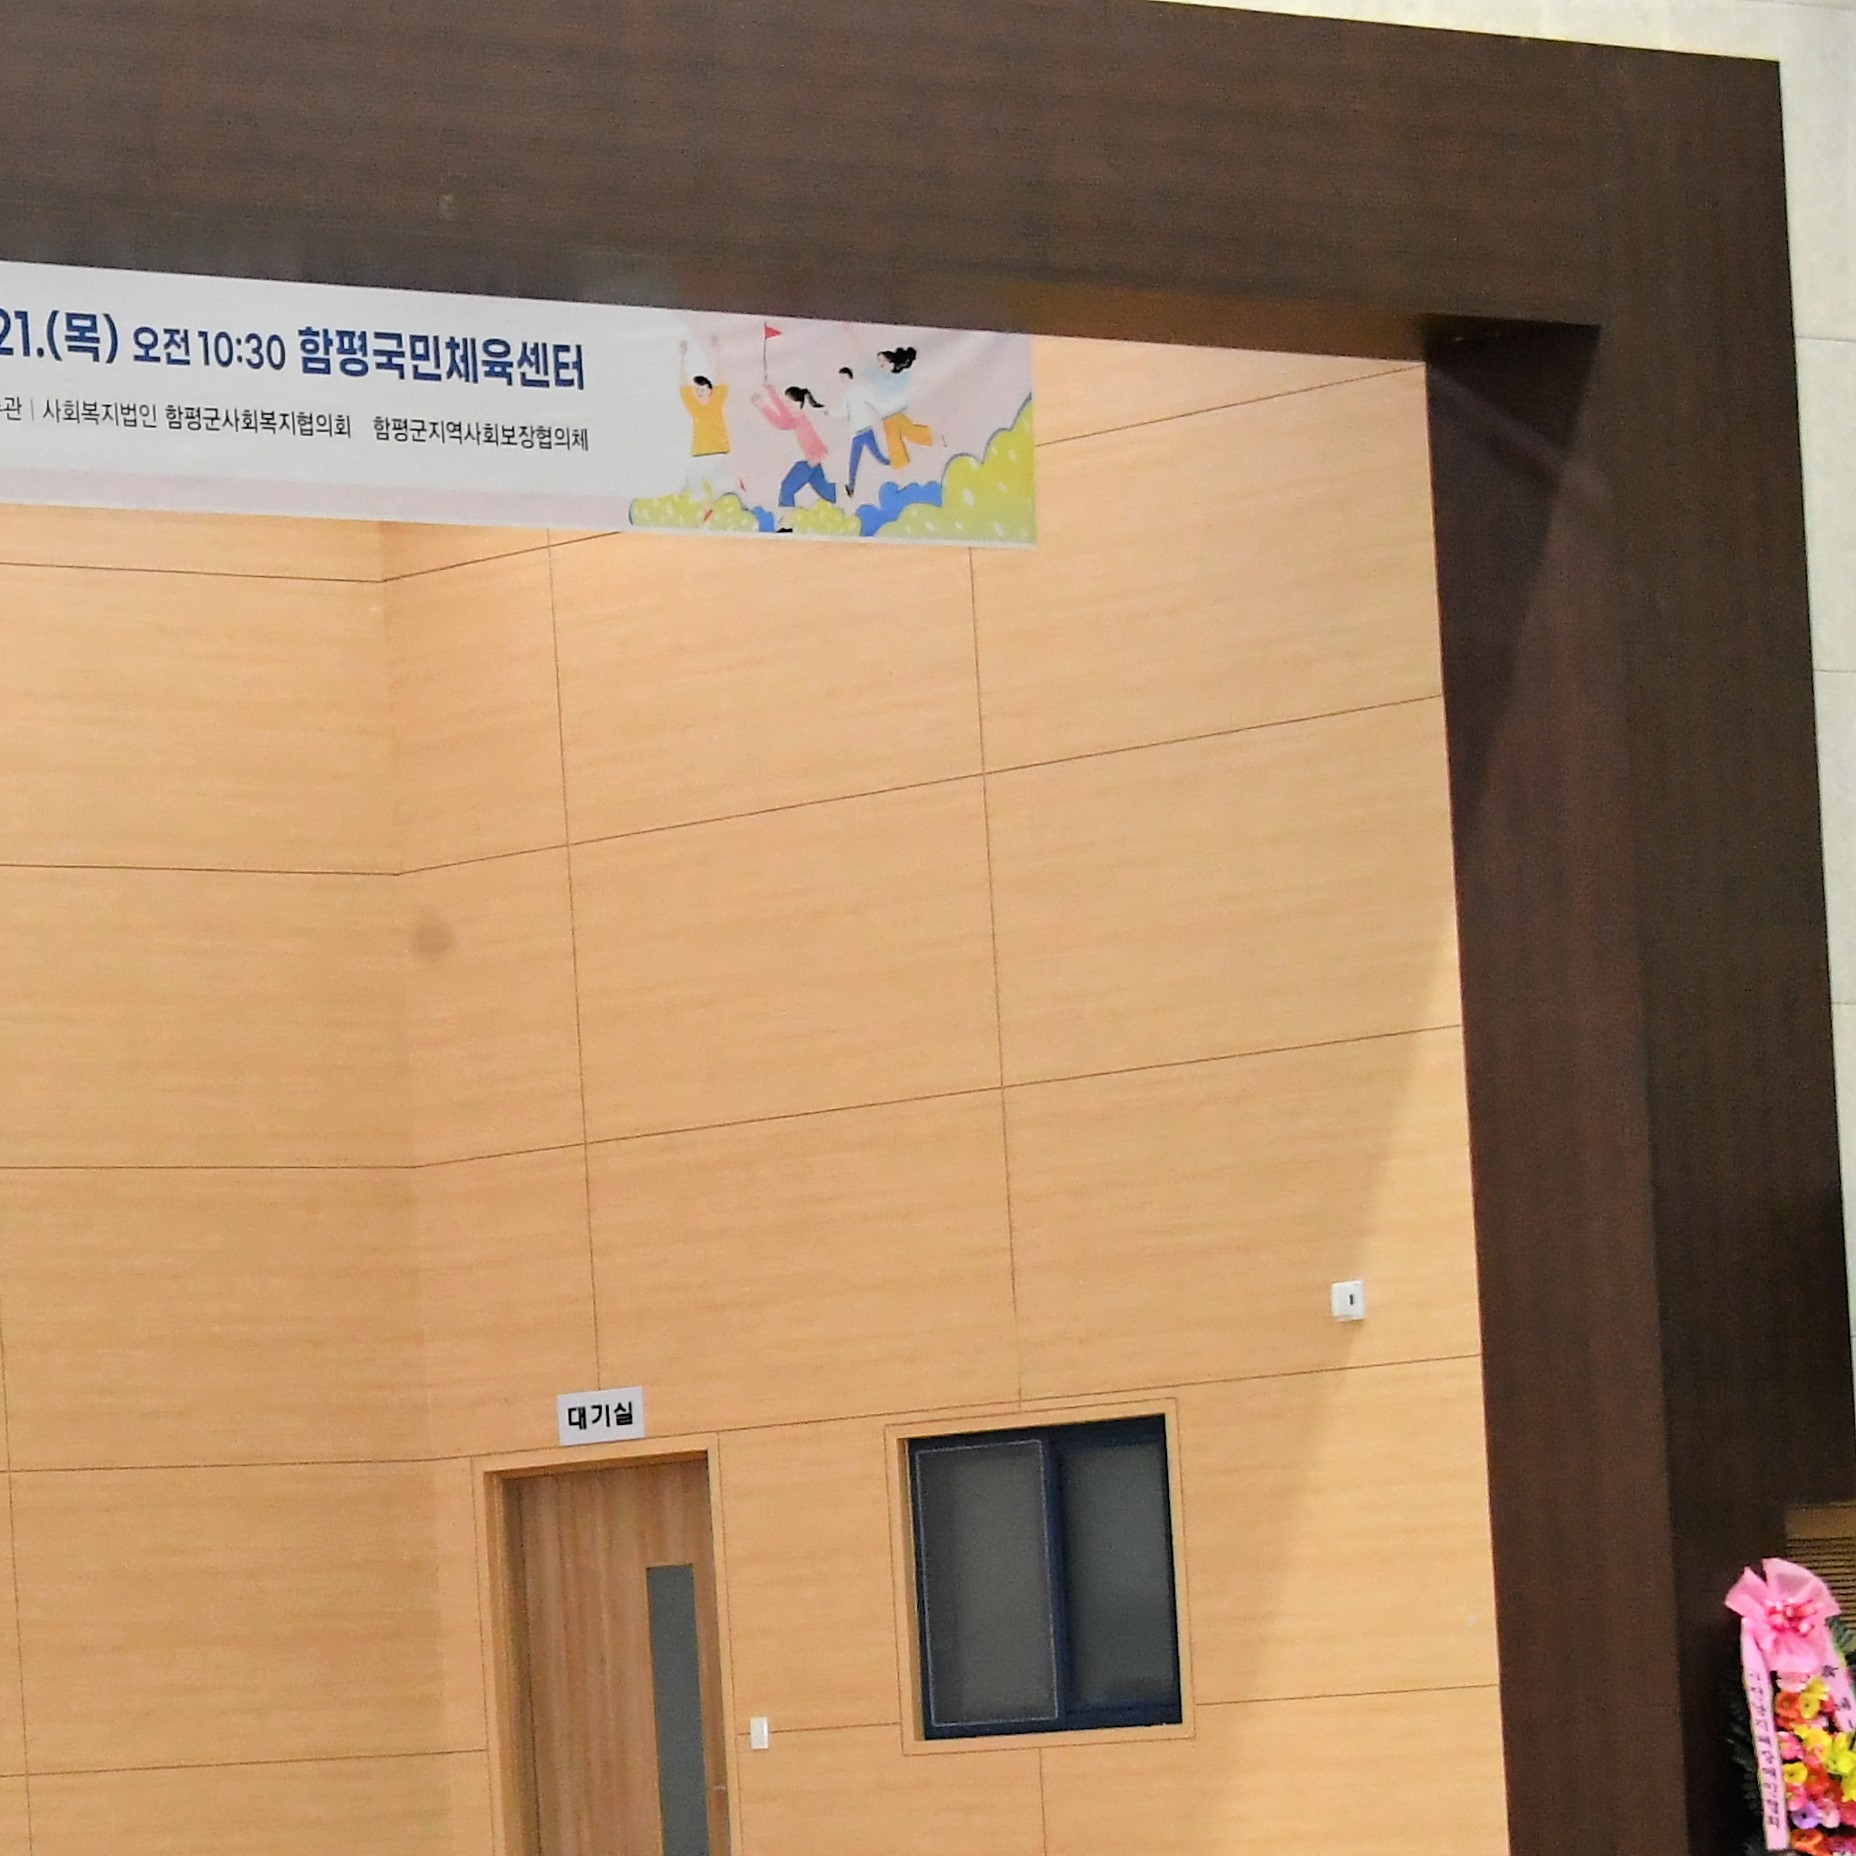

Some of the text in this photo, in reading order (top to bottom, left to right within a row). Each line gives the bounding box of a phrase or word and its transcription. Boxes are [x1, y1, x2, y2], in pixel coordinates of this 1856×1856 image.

[298, 326, 584, 390] 함평국민체육센터
[43, 399, 158, 429] 사회복지법인
[165, 404, 351, 439] 함평군사회복지협의회
[373, 415, 589, 452] 함평군지역사회보장협의체
[568, 1401, 633, 1430] 대기실
